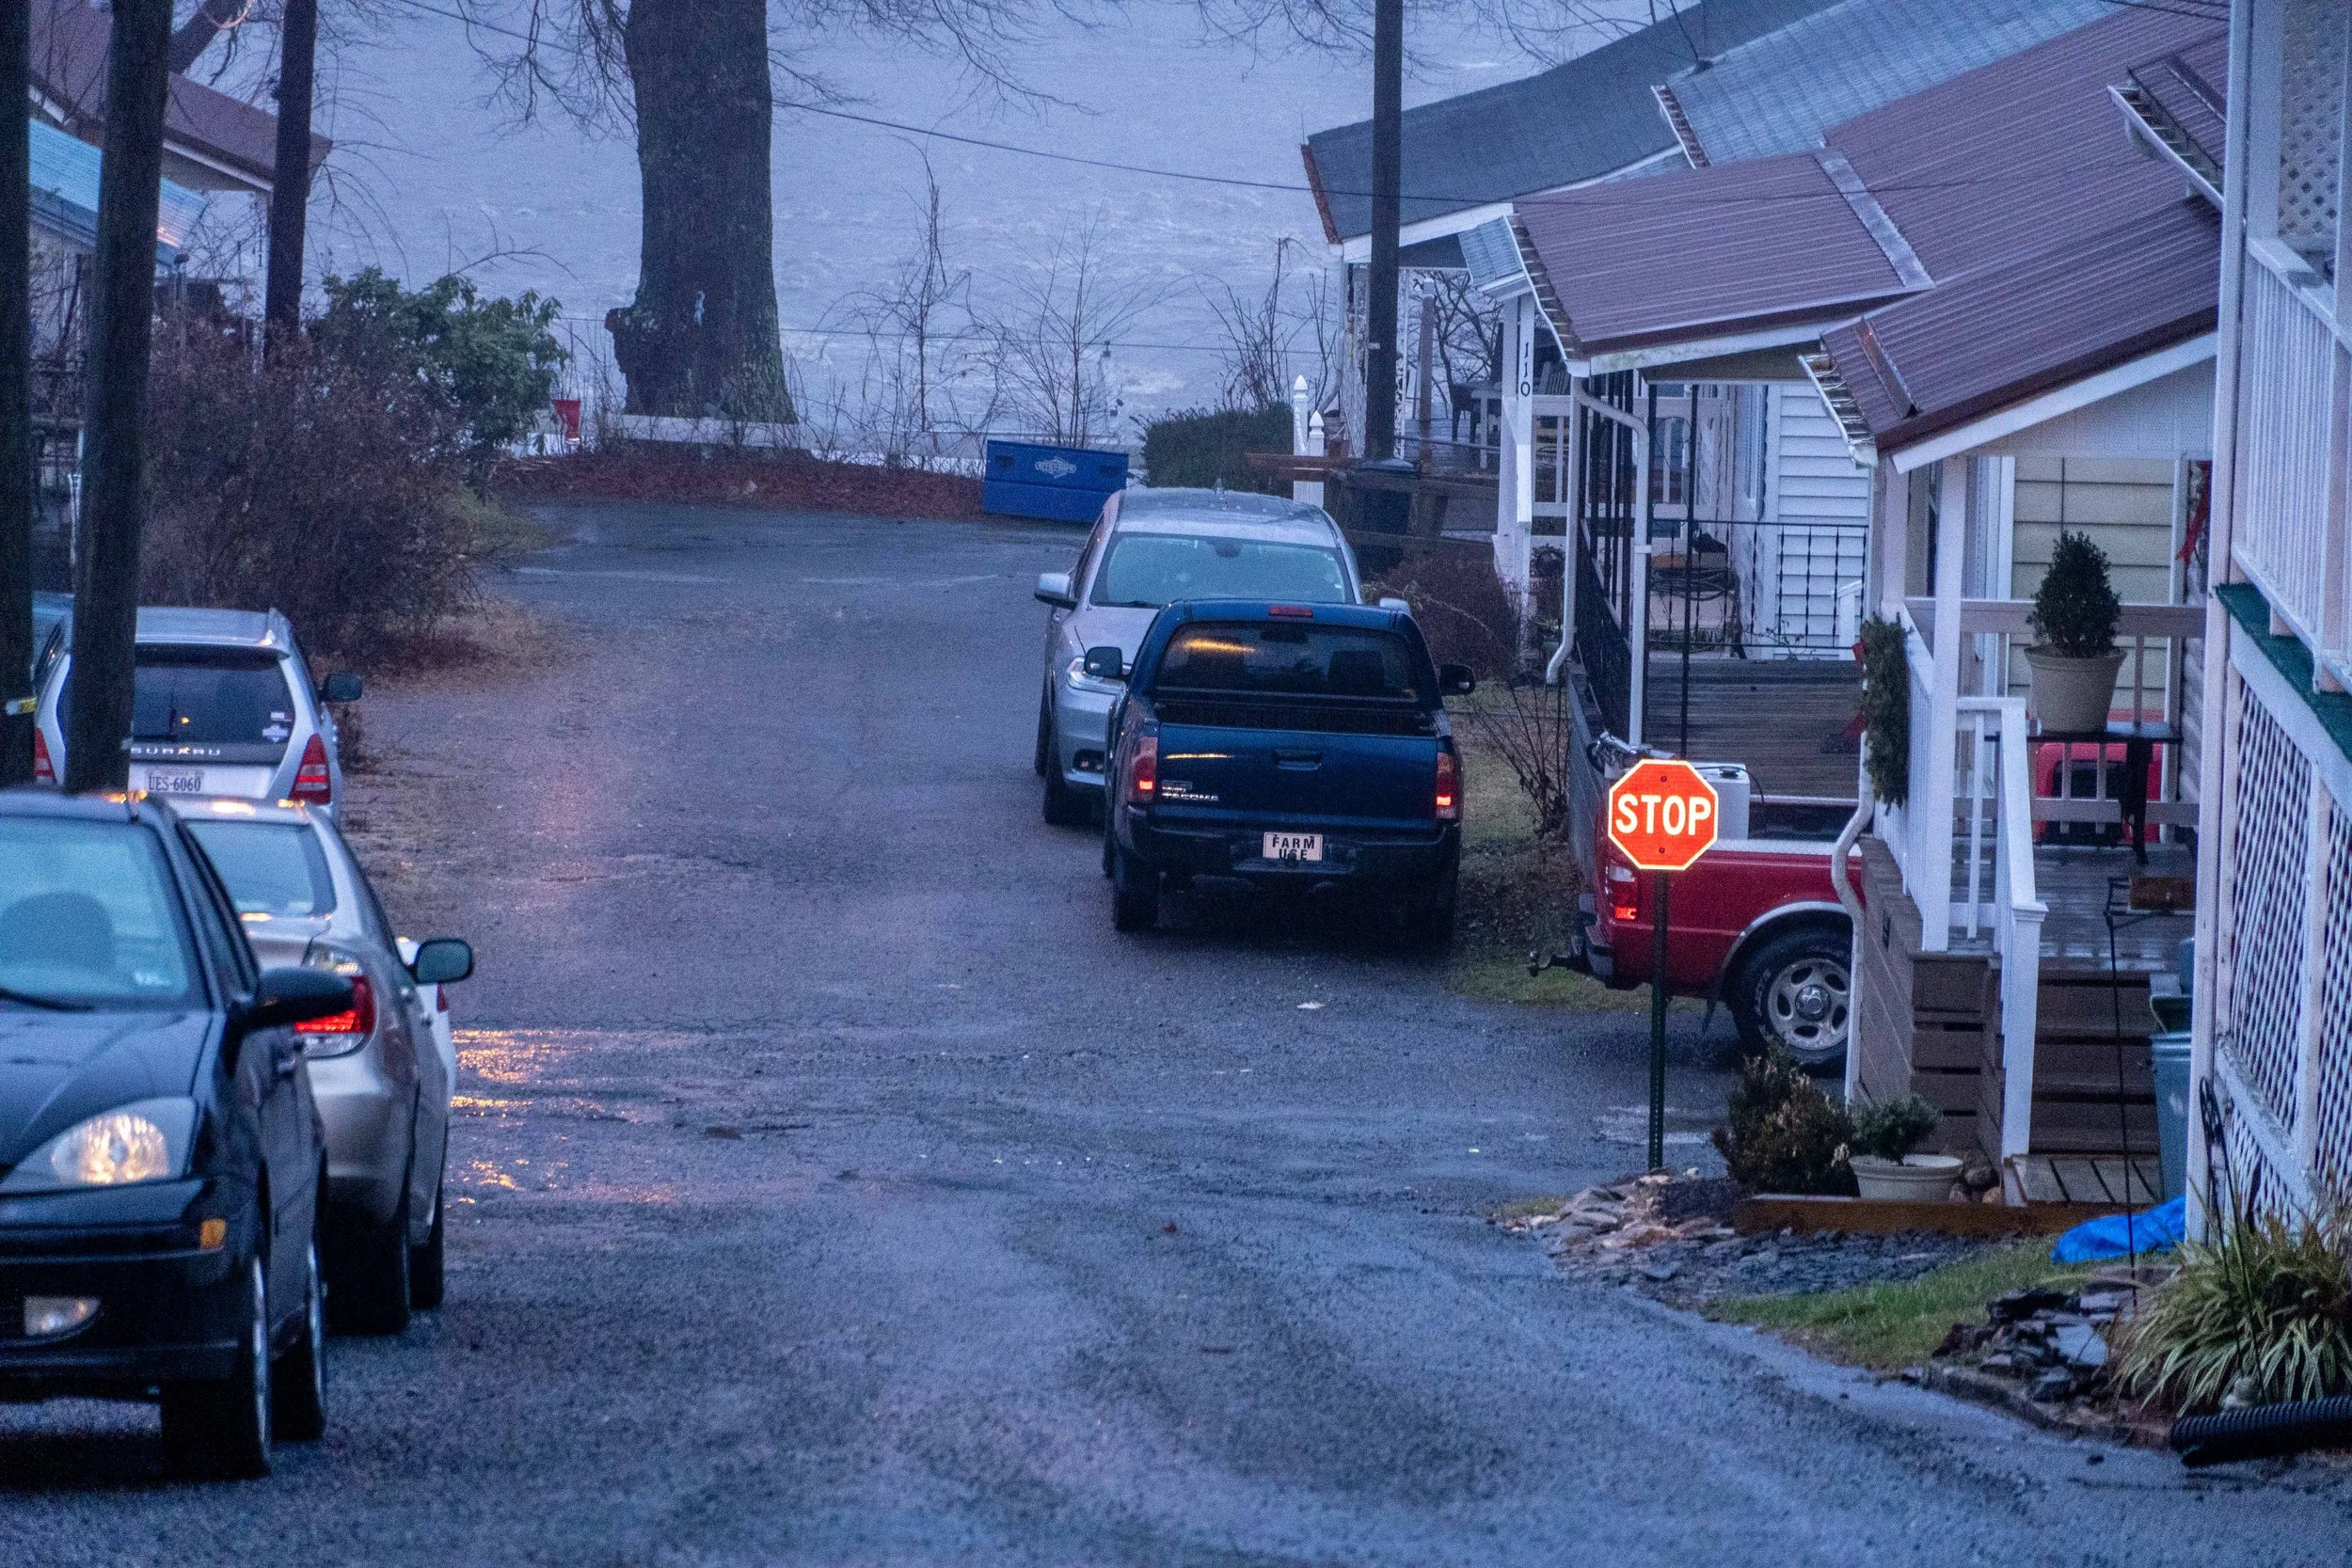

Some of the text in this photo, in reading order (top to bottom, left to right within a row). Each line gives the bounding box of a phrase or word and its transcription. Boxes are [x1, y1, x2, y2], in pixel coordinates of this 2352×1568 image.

[1520, 342, 1531, 397] 110
[131, 747, 220, 755] SUBARU
[149, 775, 201, 792] UES-6060
[1615, 793, 1712, 836] STOP
[1272, 836, 1315, 849] FARM
